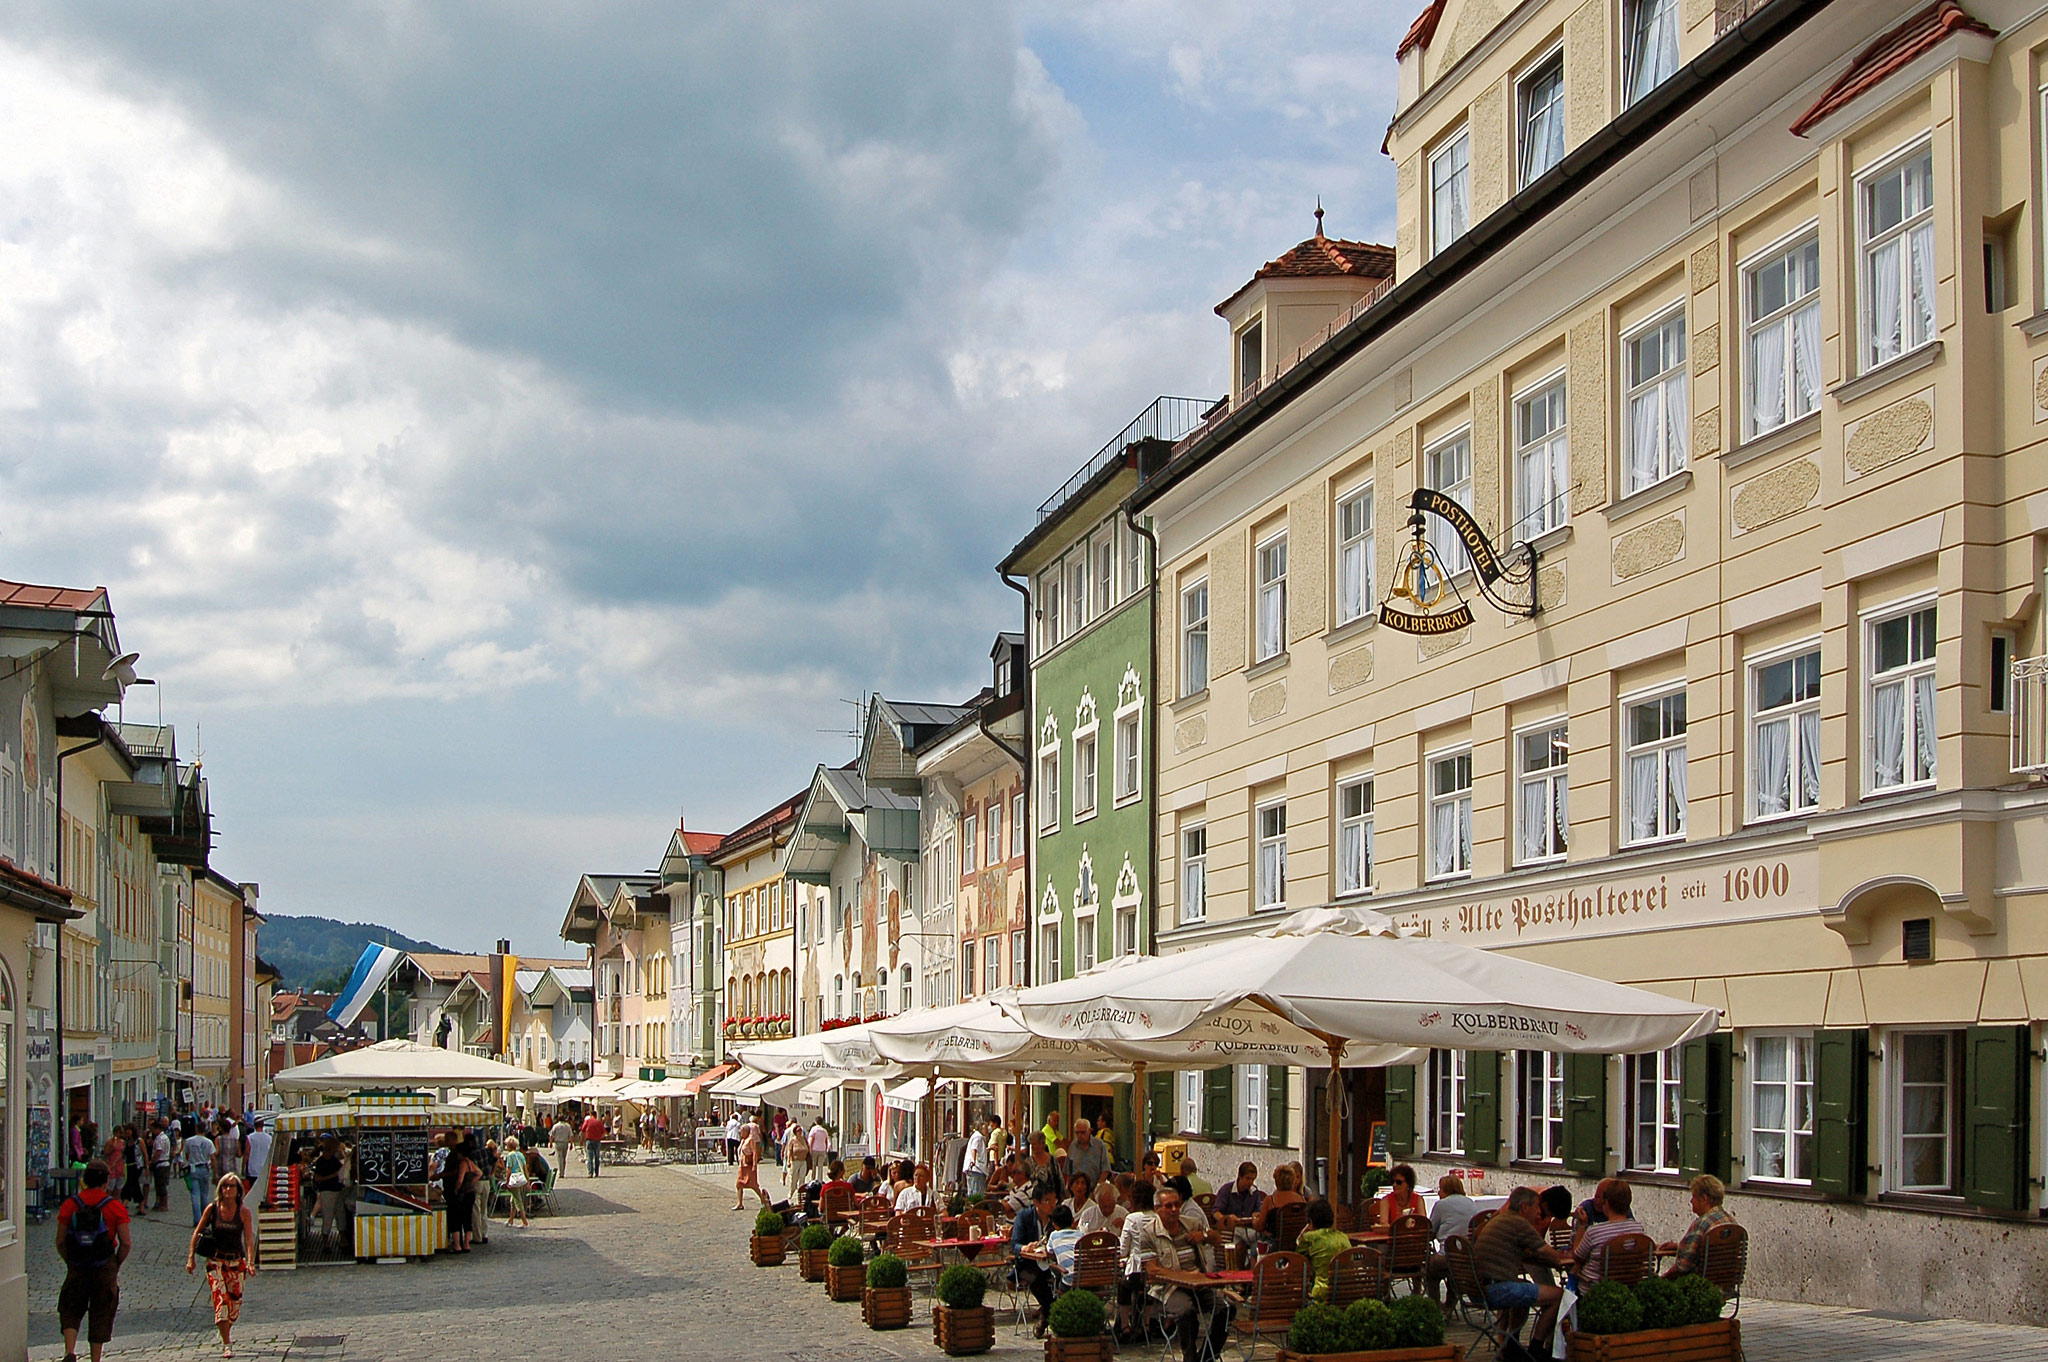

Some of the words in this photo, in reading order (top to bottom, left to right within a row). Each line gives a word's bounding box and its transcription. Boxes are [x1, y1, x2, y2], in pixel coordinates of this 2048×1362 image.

[1430, 494, 1487, 572] POSTHOTEL
[1384, 609, 1469, 632] KOLBERBRÄU
[1458, 903, 1503, 934] Alte
[1511, 875, 1668, 937] Posthalterei
[1681, 880, 1706, 900] seit
[1722, 862, 1790, 903] 1600
[1452, 1013, 1558, 1036] KOLBERBRÄU
